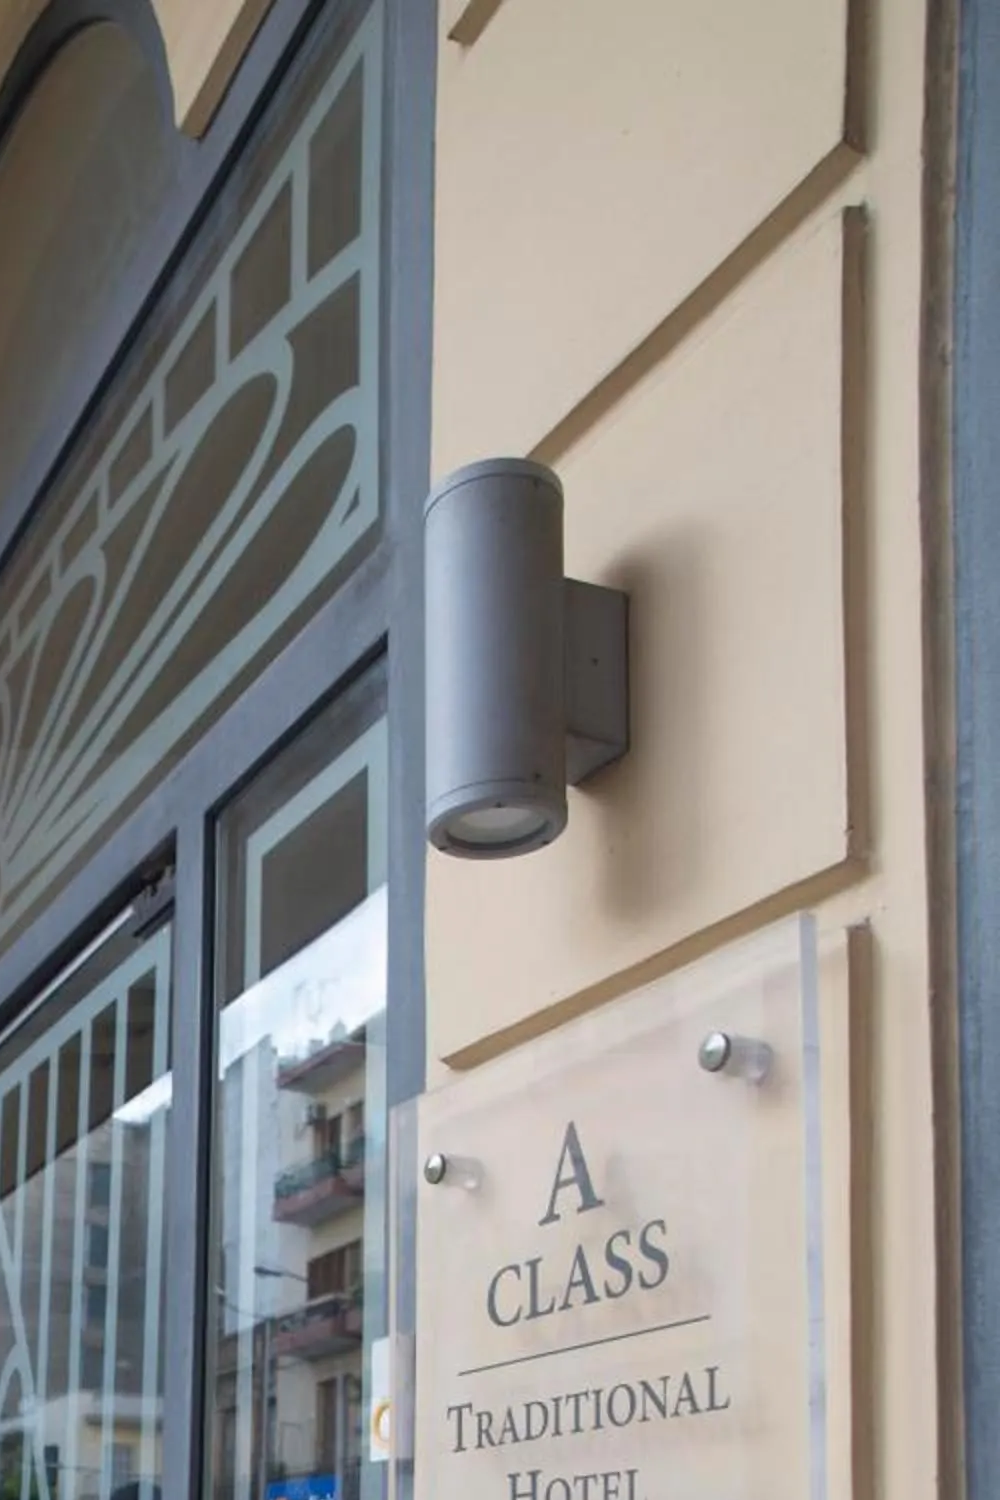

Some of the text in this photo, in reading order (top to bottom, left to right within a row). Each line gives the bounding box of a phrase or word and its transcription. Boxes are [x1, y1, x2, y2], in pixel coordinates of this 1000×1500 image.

[539, 1121, 604, 1226] A
[488, 1219, 670, 1327] CLASS
[448, 1366, 730, 1453] TRADITIONAL
